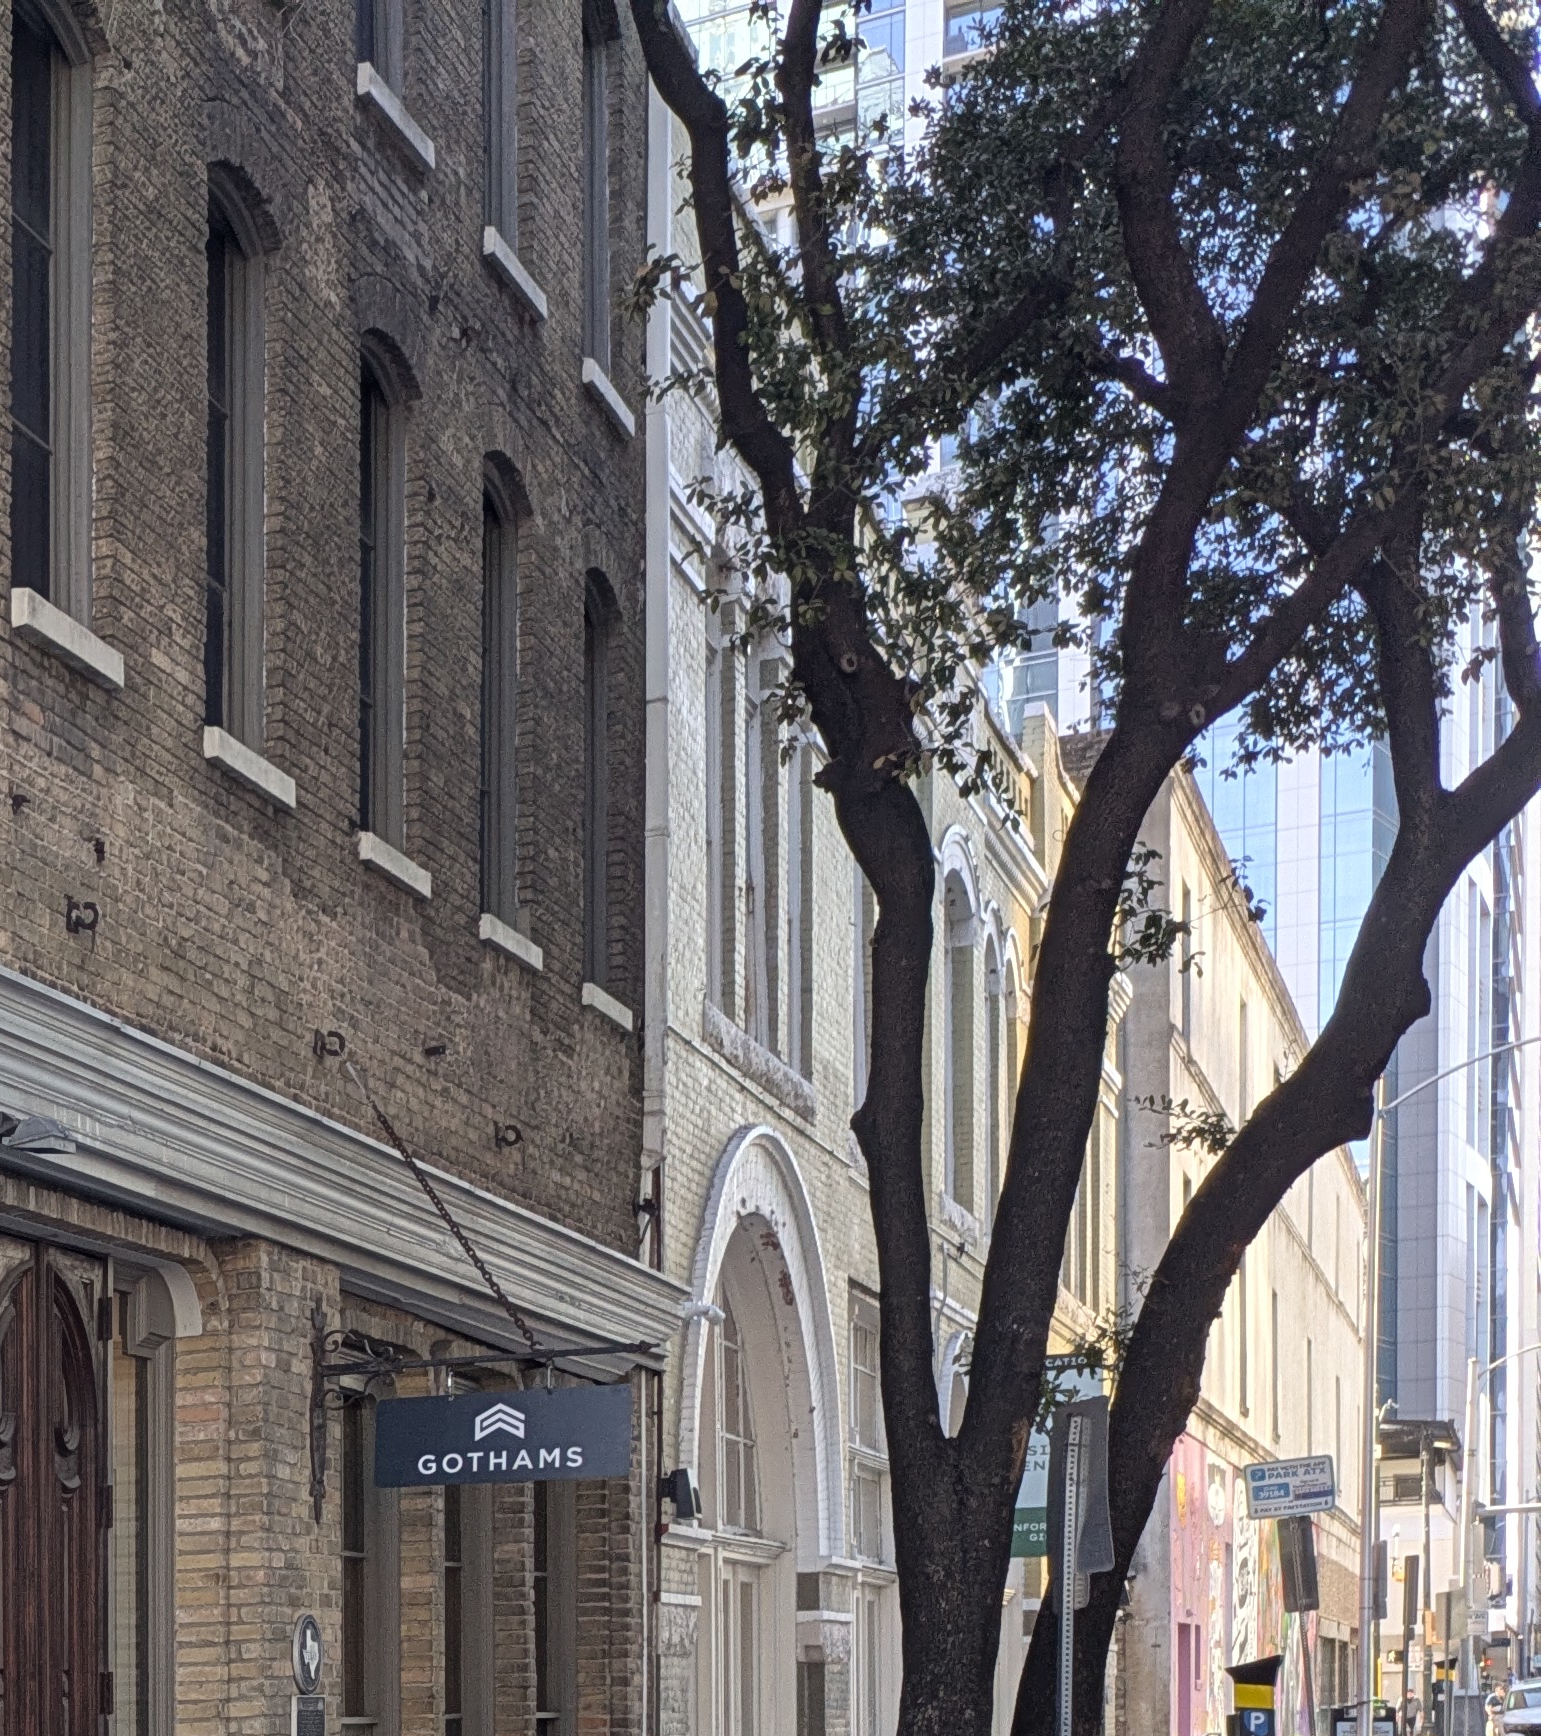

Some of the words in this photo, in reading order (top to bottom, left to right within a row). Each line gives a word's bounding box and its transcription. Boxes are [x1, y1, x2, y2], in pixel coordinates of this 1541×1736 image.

[1045, 1357, 1088, 1368] CATIO
[1027, 1444, 1050, 1456] SI
[417, 1446, 584, 1476] GOTHAMS
[1268, 1470, 1299, 1480] PARK
[1303, 1467, 1327, 1476] ATX
[1013, 1522, 1047, 1533] NFOR
[1029, 1532, 1047, 1542] GI
[1250, 1711, 1265, 1732] P
